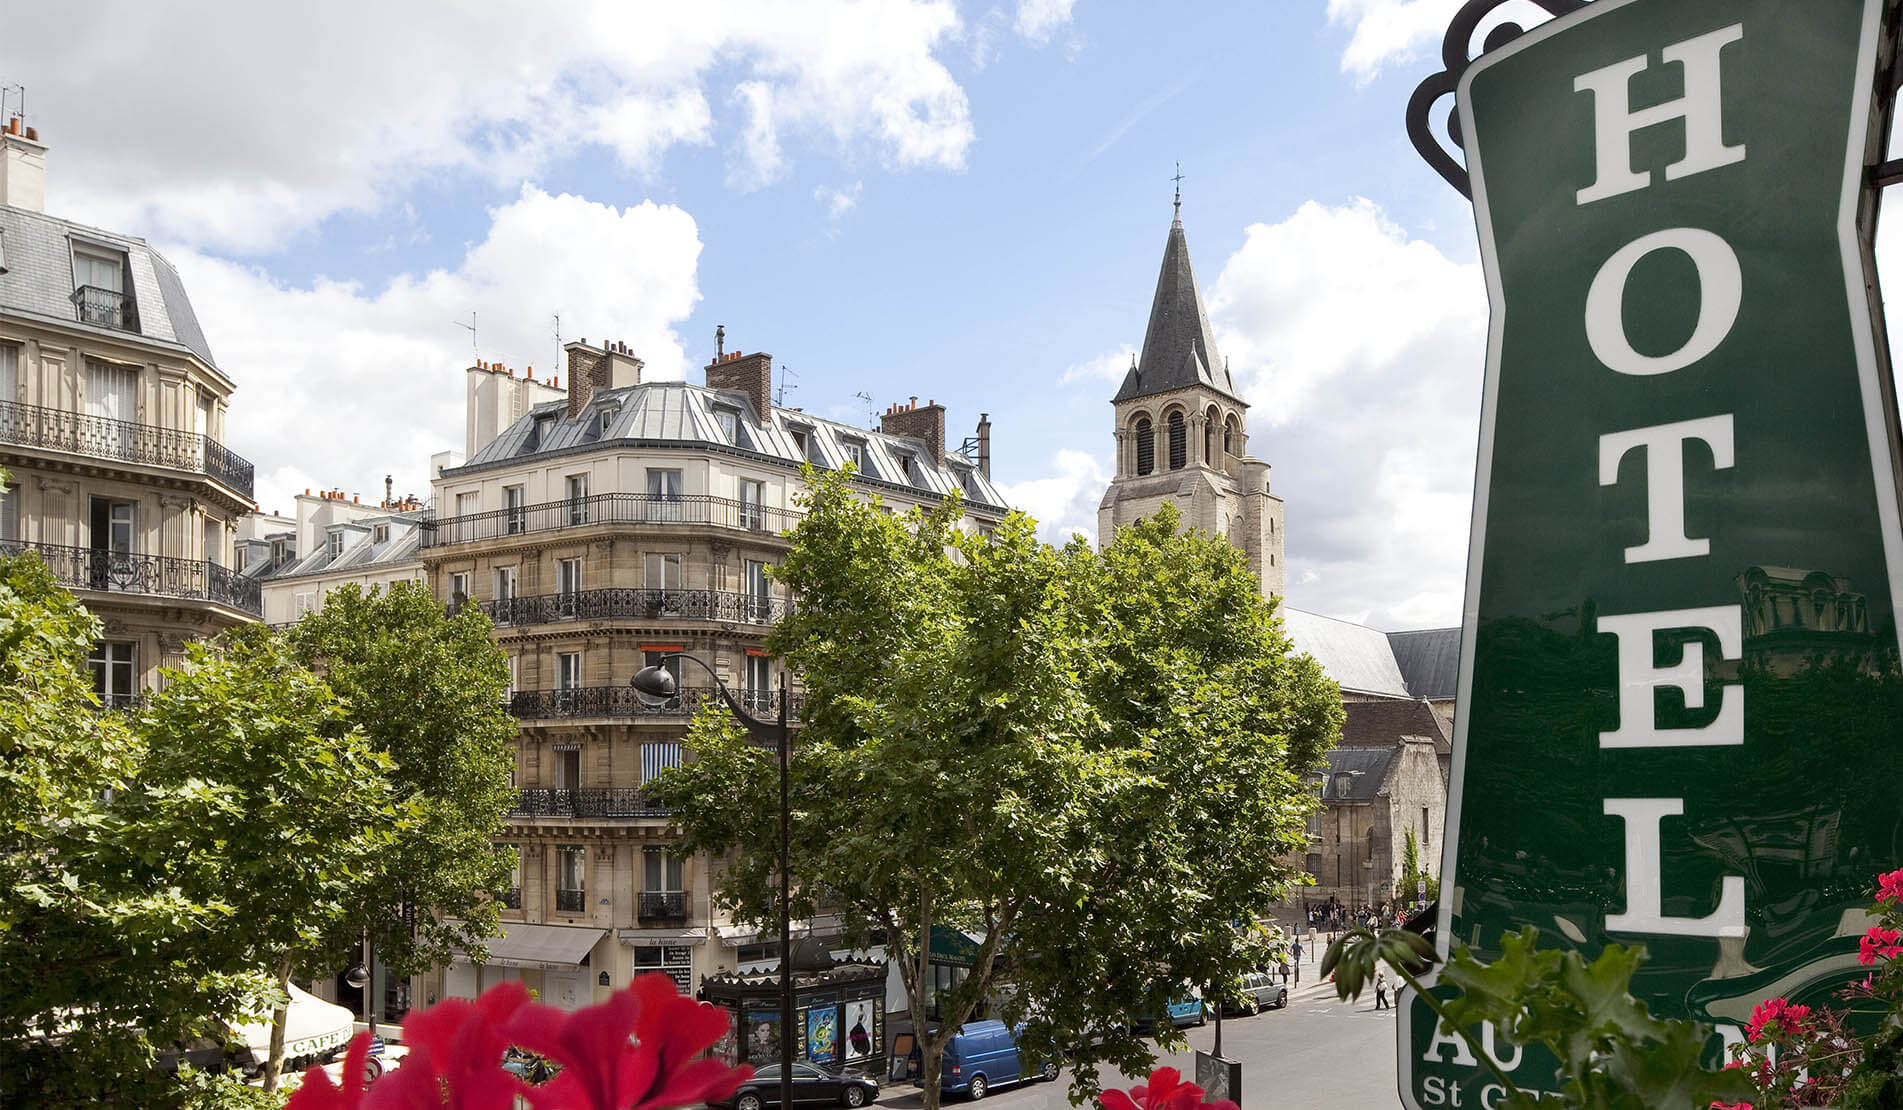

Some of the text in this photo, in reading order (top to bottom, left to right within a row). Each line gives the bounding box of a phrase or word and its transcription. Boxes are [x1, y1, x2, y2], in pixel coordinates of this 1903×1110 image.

[1574, 23, 1746, 938] HOTEL
[293, 1033, 339, 1053] CAFE
[1423, 1076, 1462, 1107] St
